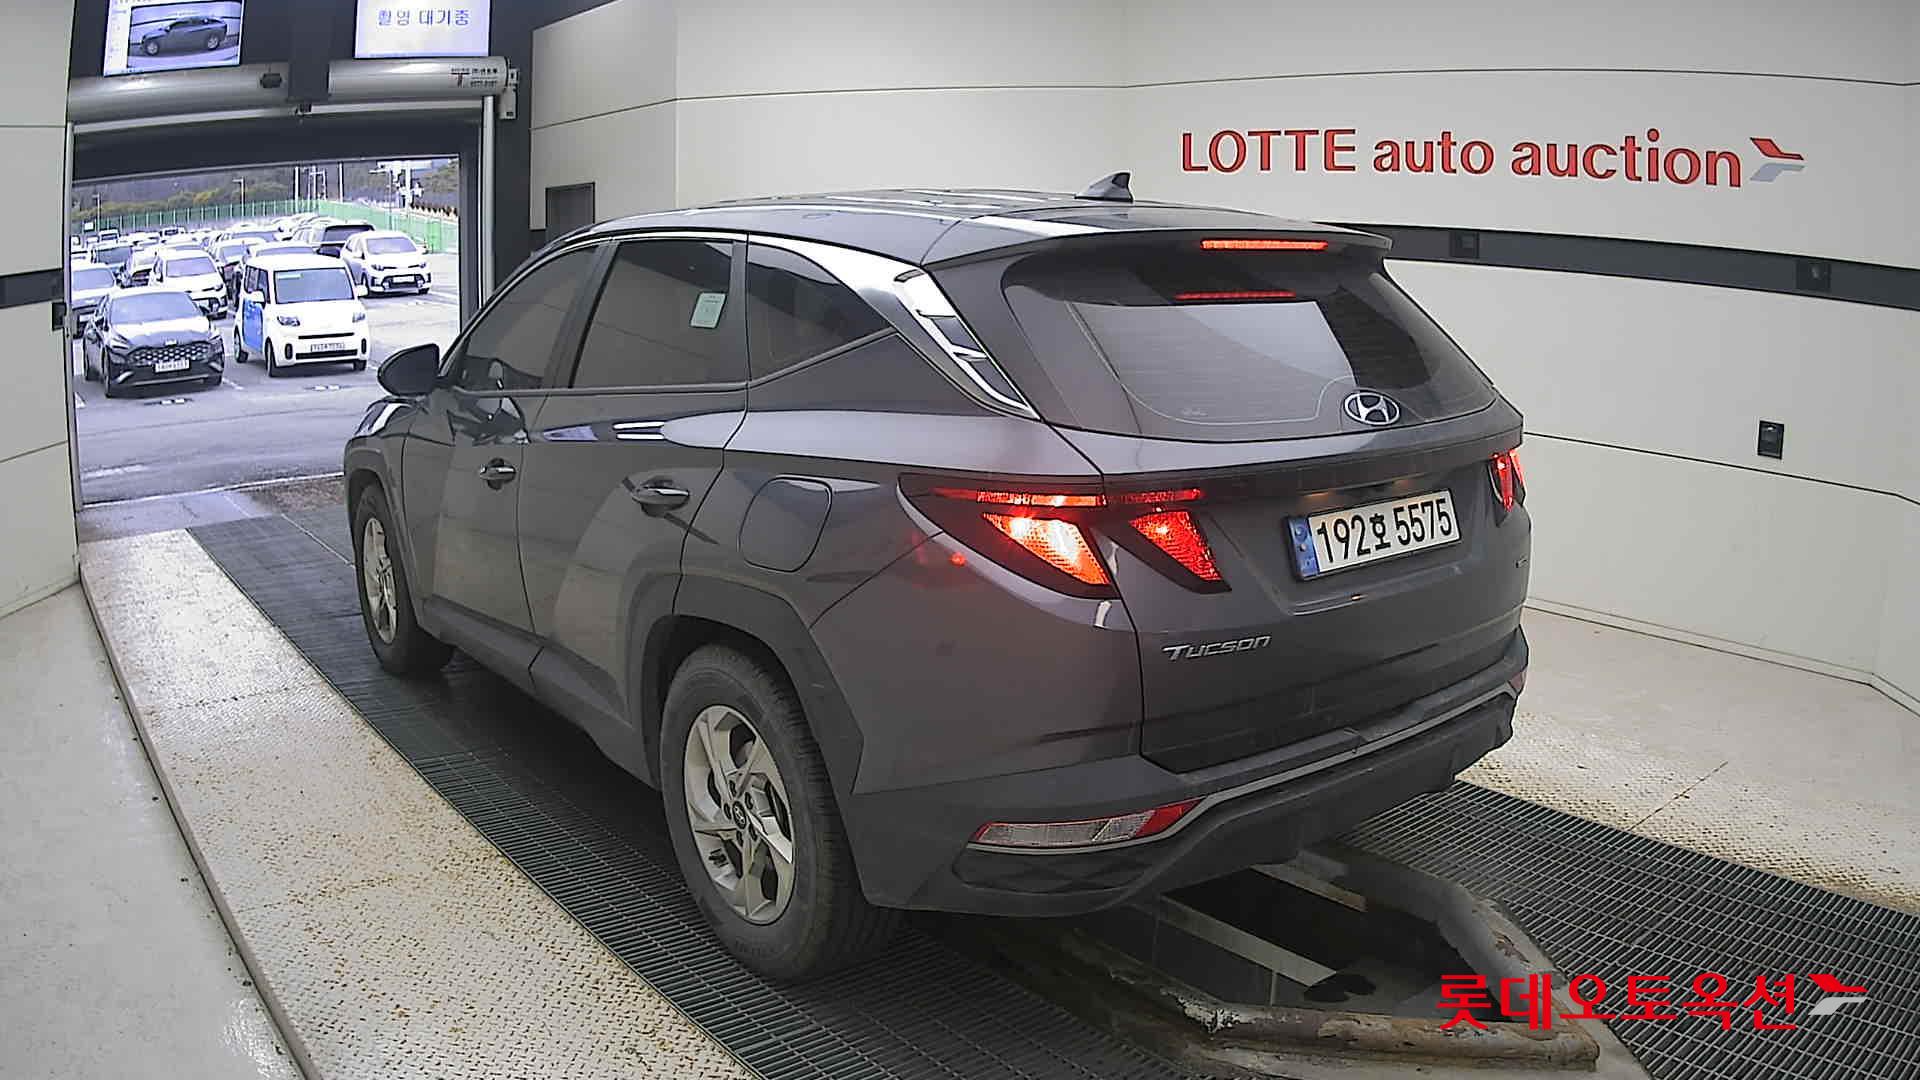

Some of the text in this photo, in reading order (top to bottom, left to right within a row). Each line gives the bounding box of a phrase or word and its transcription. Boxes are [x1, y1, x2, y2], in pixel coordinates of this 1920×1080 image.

[419, 9, 469, 26] 대기중
[1181, 128, 1741, 187] LOTTE auto auction
[1316, 498, 1452, 563] 192호 5575
